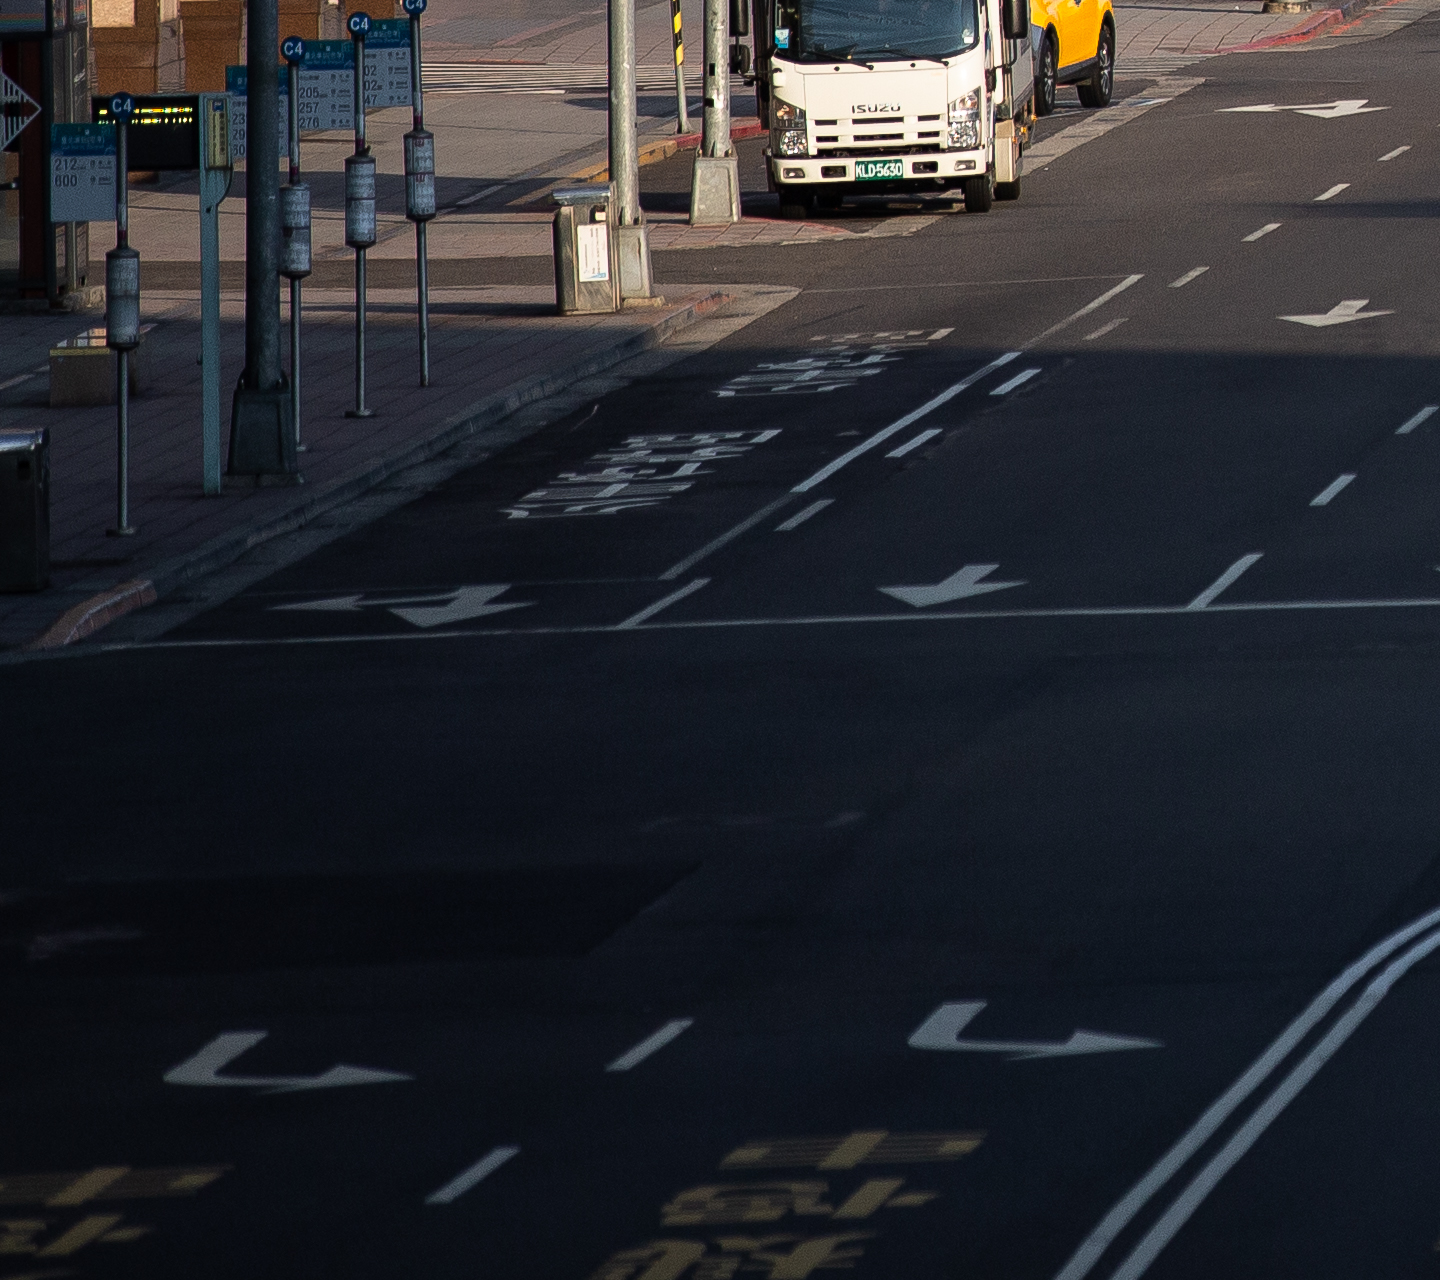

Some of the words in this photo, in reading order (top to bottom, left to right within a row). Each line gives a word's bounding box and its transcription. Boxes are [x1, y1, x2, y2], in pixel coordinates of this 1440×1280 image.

[350, 17, 369, 31] C4
[283, 41, 303, 56] C4
[112, 98, 132, 113] C4
[851, 103, 901, 115] ISUZU
[54, 158, 78, 171] 212
[855, 160, 904, 177] KLD-5630
